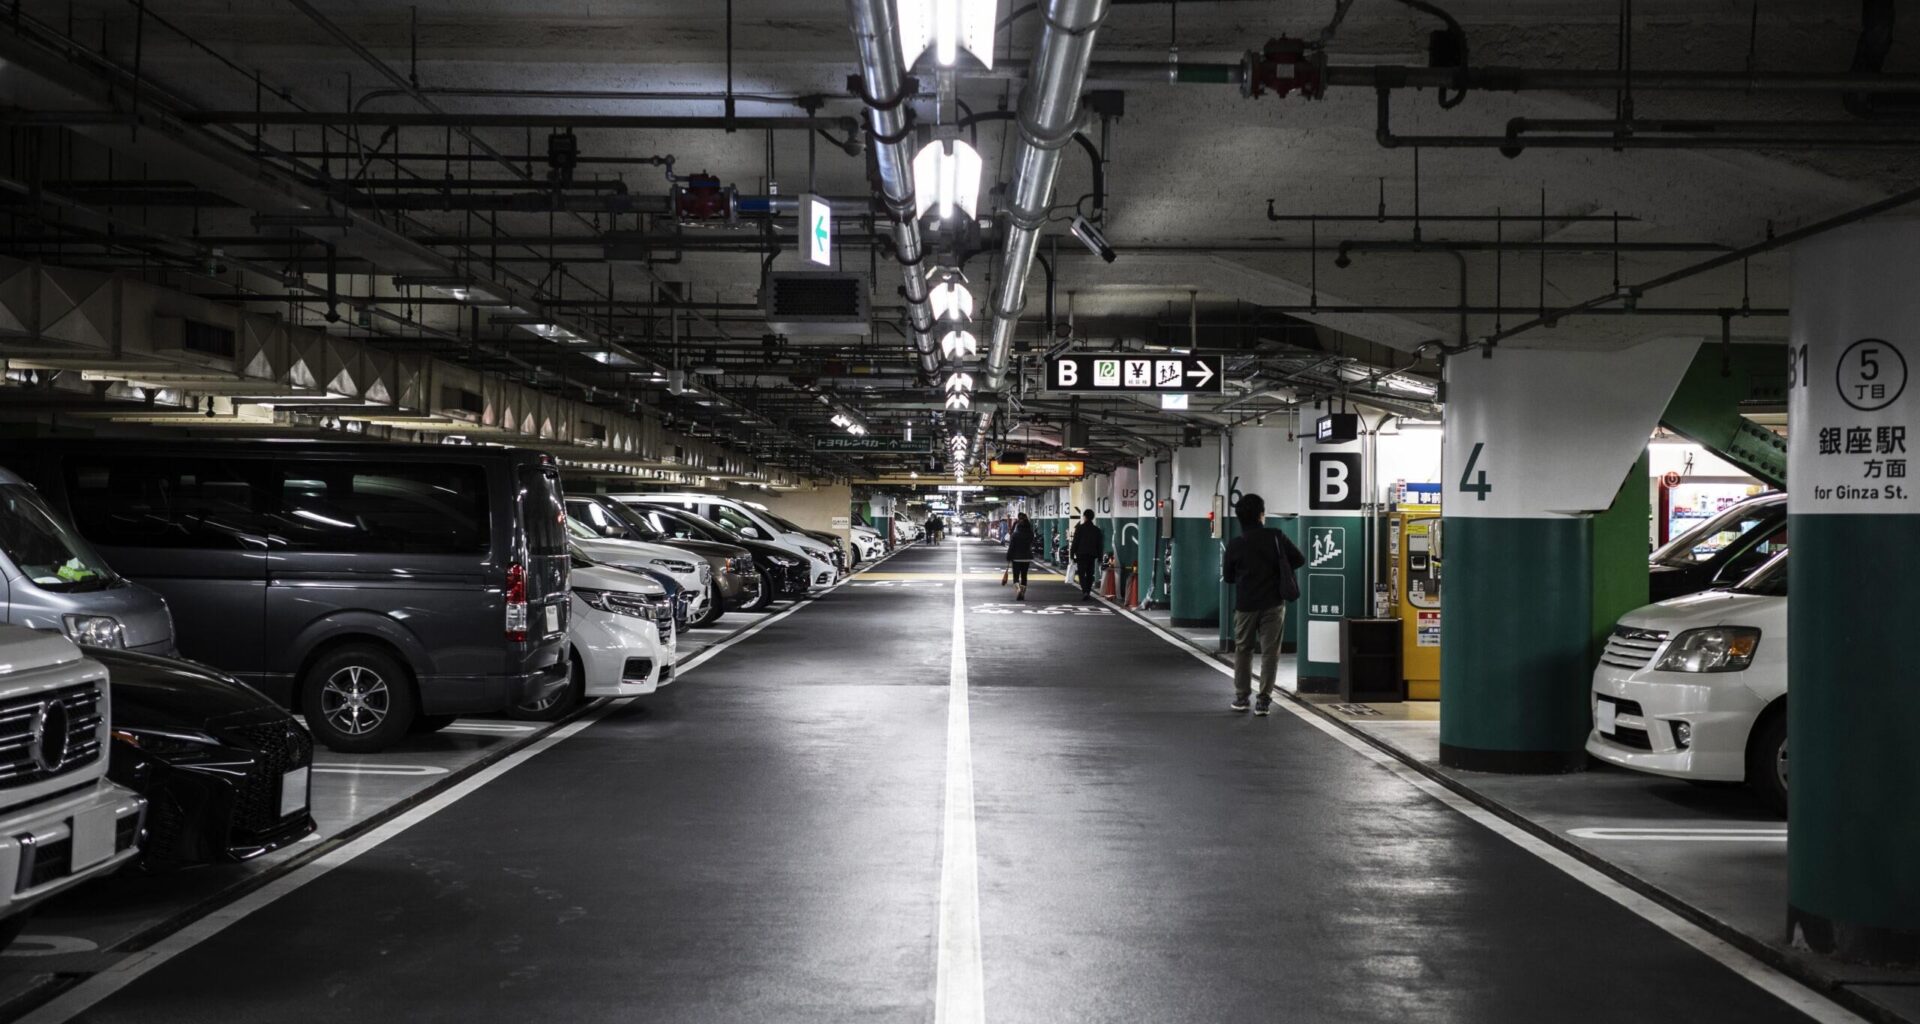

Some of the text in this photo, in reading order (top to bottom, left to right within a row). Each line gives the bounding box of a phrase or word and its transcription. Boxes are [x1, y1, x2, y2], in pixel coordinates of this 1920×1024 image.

[1058, 360, 1078, 386] B
[1860, 349, 1879, 381] 5
[1854, 384, 1885, 399] 丁目
[817, 439, 887, 448] トヨタレンタカー
[1819, 426, 1906, 455] 銀座駅
[1459, 442, 1492, 501] 4
[1863, 459, 1907, 478] 方面
[1230, 476, 1243, 508] 6
[1319, 460, 1349, 503] B
[1815, 485, 1908, 500] for Ginza St.
[1097, 497, 1110, 514] 10
[1143, 489, 1154, 511] 8
[1178, 485, 1190, 510] 7
